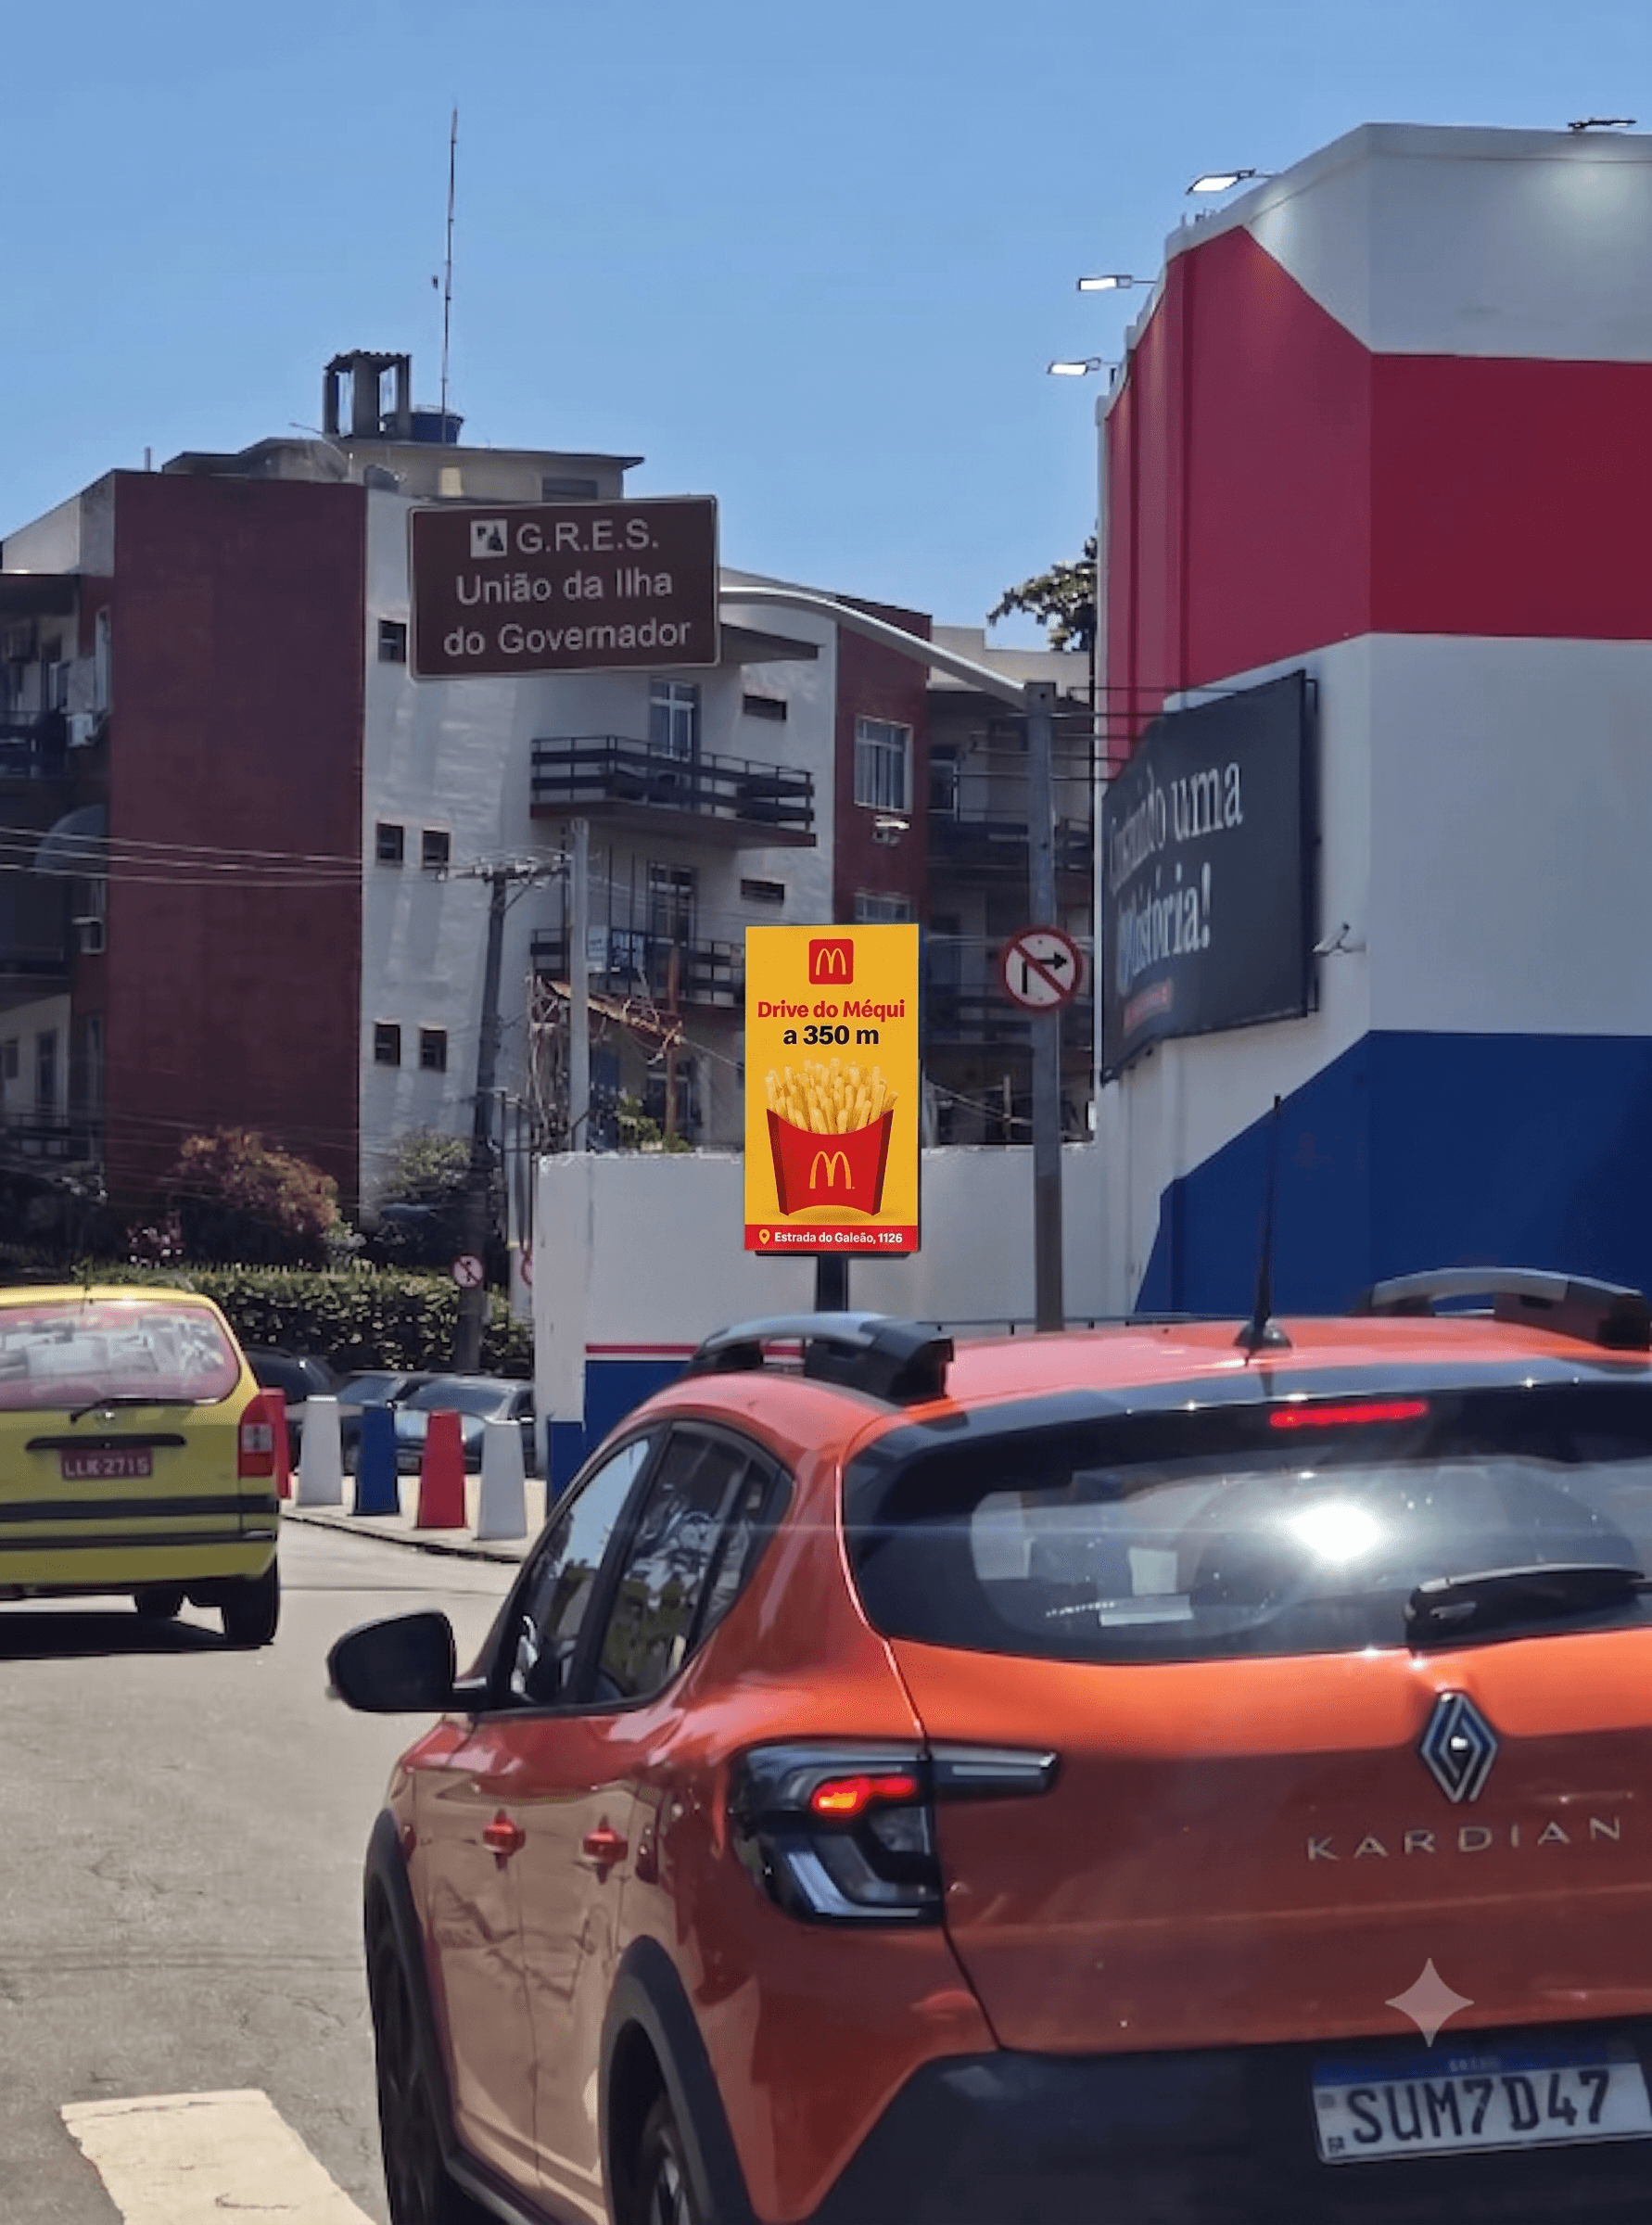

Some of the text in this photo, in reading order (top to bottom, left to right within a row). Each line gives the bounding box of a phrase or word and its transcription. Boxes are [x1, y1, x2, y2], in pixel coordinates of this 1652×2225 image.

[515, 518, 659, 554] G.R.E.S.
[455, 566, 673, 605] União da Ilha
[443, 617, 692, 656] do Governador
[1170, 762, 1243, 843] uma
[757, 998, 906, 1023] Drive do Méqui
[782, 1024, 880, 1045] a 350 m
[774, 1231, 903, 1245] Estrada do Galeão, 1126
[1307, 1816, 1621, 1862] KARDIAN
[1346, 2069, 1611, 2145] SUM7D47
